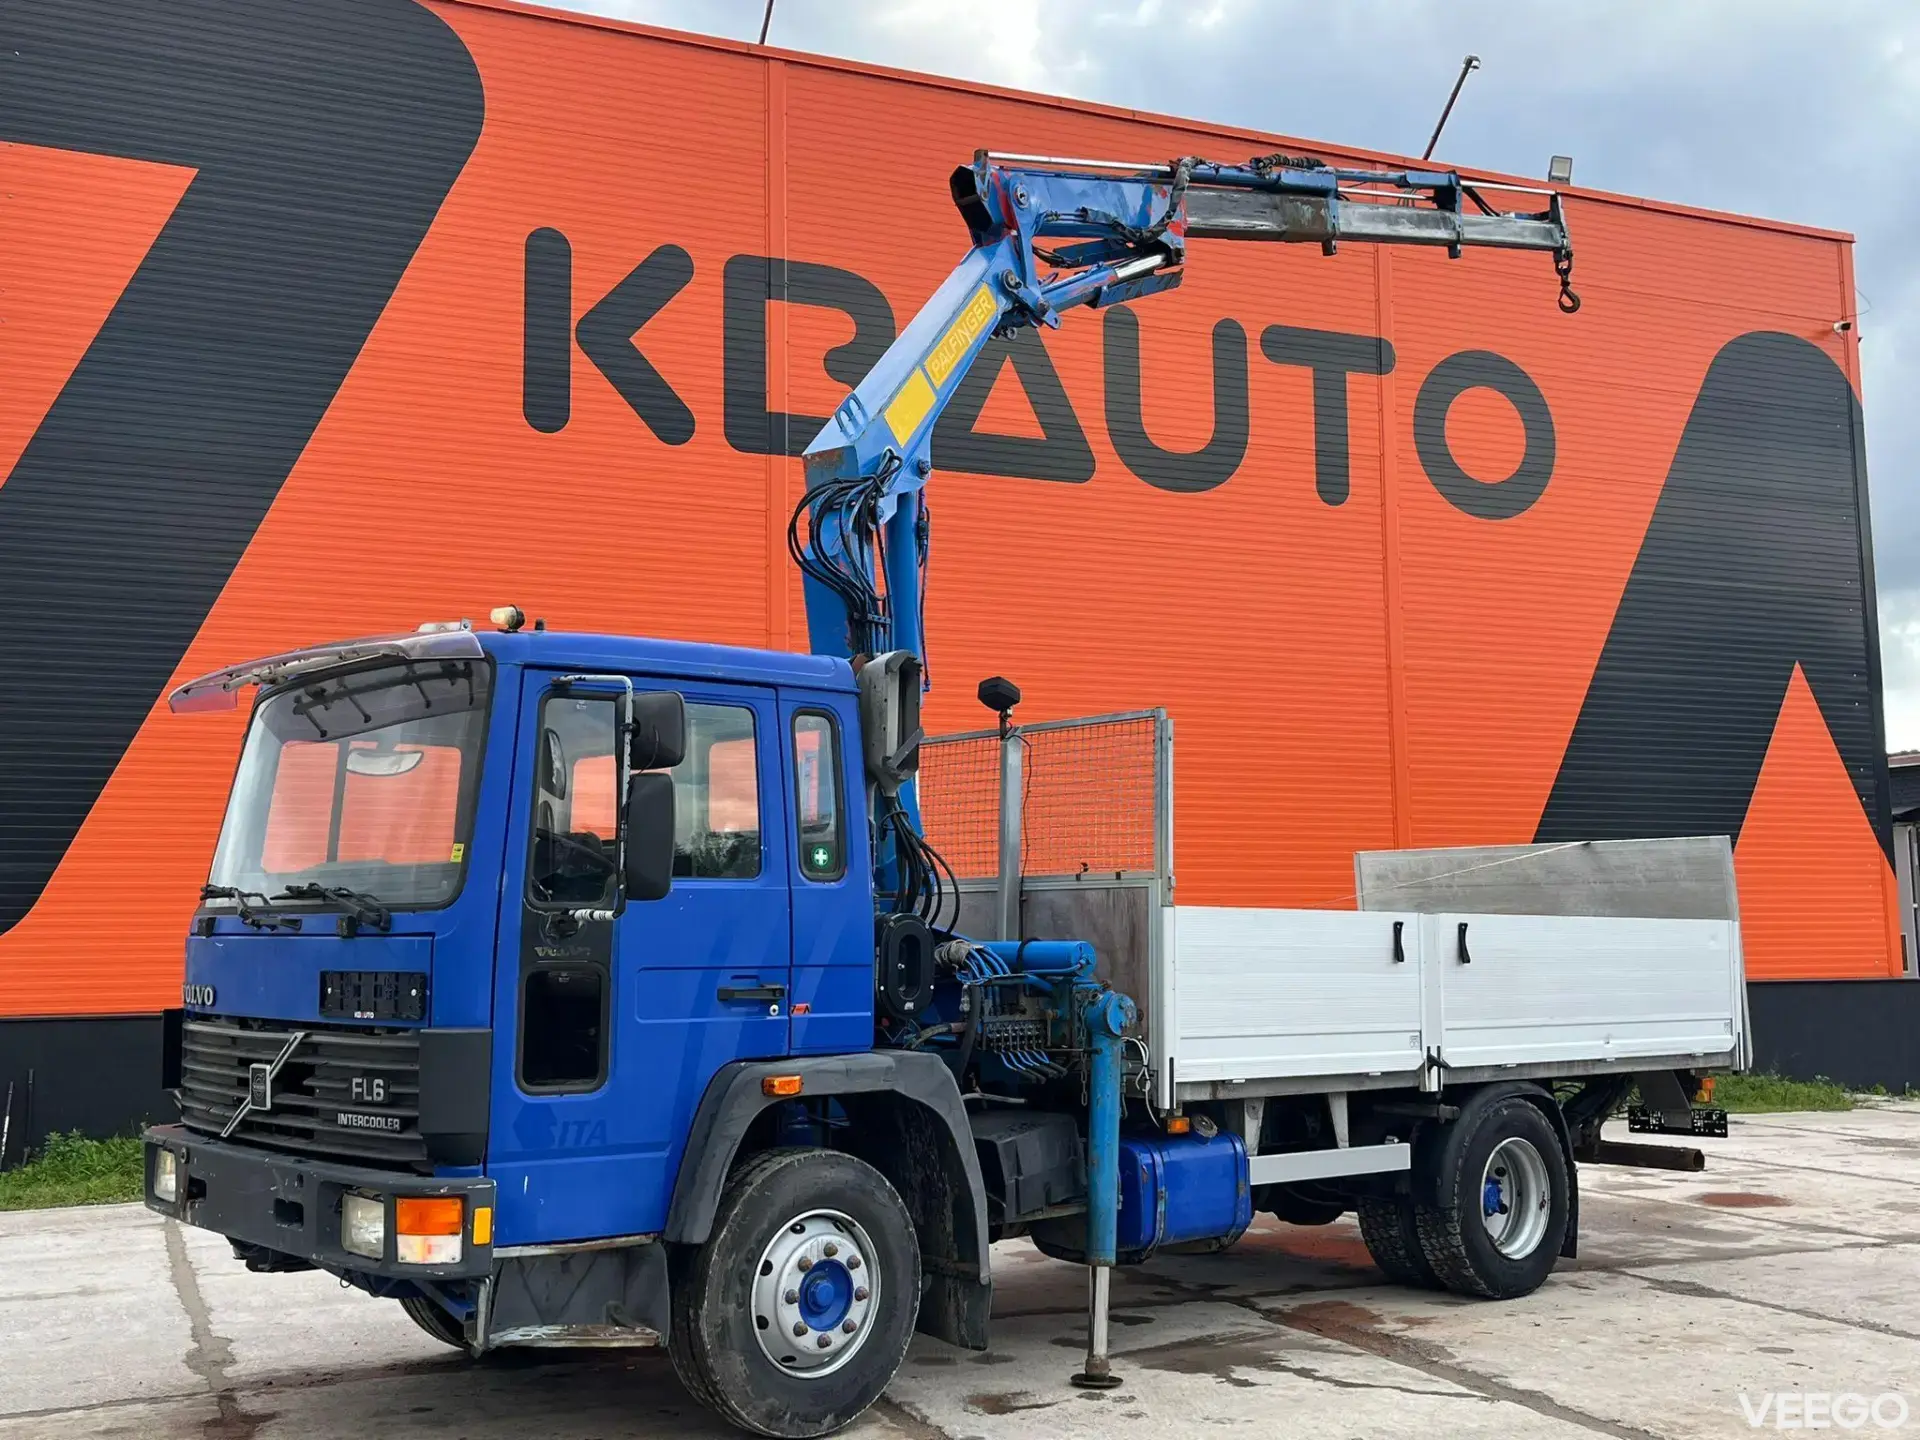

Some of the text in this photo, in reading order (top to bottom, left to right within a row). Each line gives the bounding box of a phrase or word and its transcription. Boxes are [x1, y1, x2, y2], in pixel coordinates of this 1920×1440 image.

[930, 293, 995, 379] PALFINGER
[352, 1077, 385, 1102] FL6
[337, 1112, 401, 1131] INTERCOOLER
